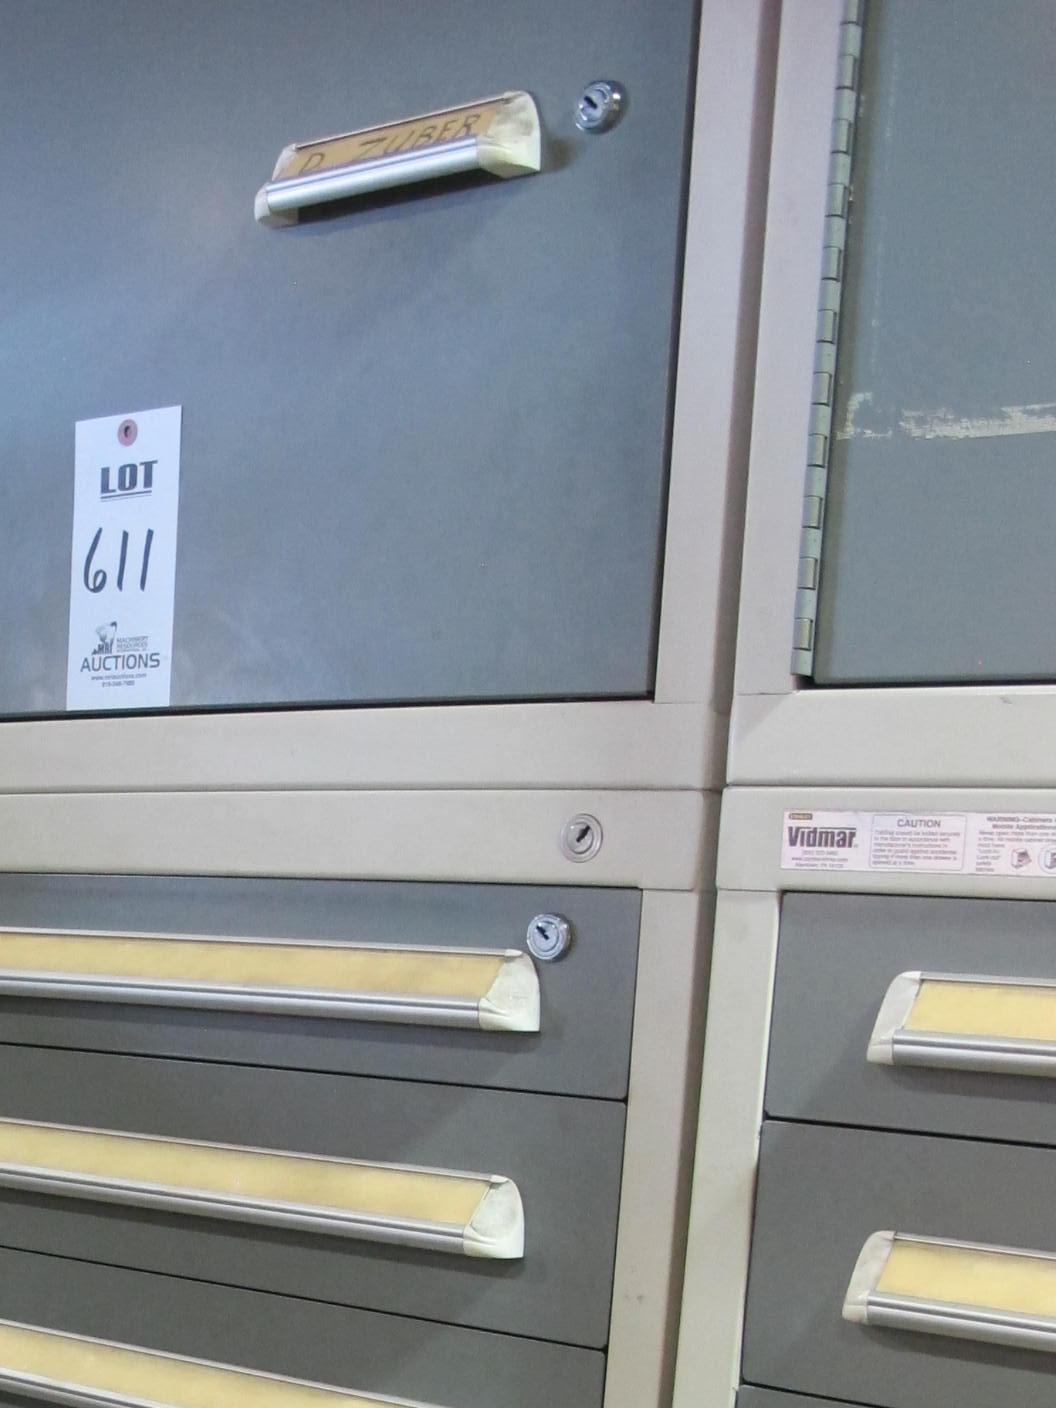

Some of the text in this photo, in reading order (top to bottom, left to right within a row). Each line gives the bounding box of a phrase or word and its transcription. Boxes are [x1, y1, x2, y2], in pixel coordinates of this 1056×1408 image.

[354, 114, 481, 156] ZUBER
[100, 460, 158, 494] LOT
[83, 527, 154, 593] 611
[80, 652, 160, 672] AUCTIONS
[788, 826, 857, 848] Vidmar
[896, 818, 941, 828] CAUTION
